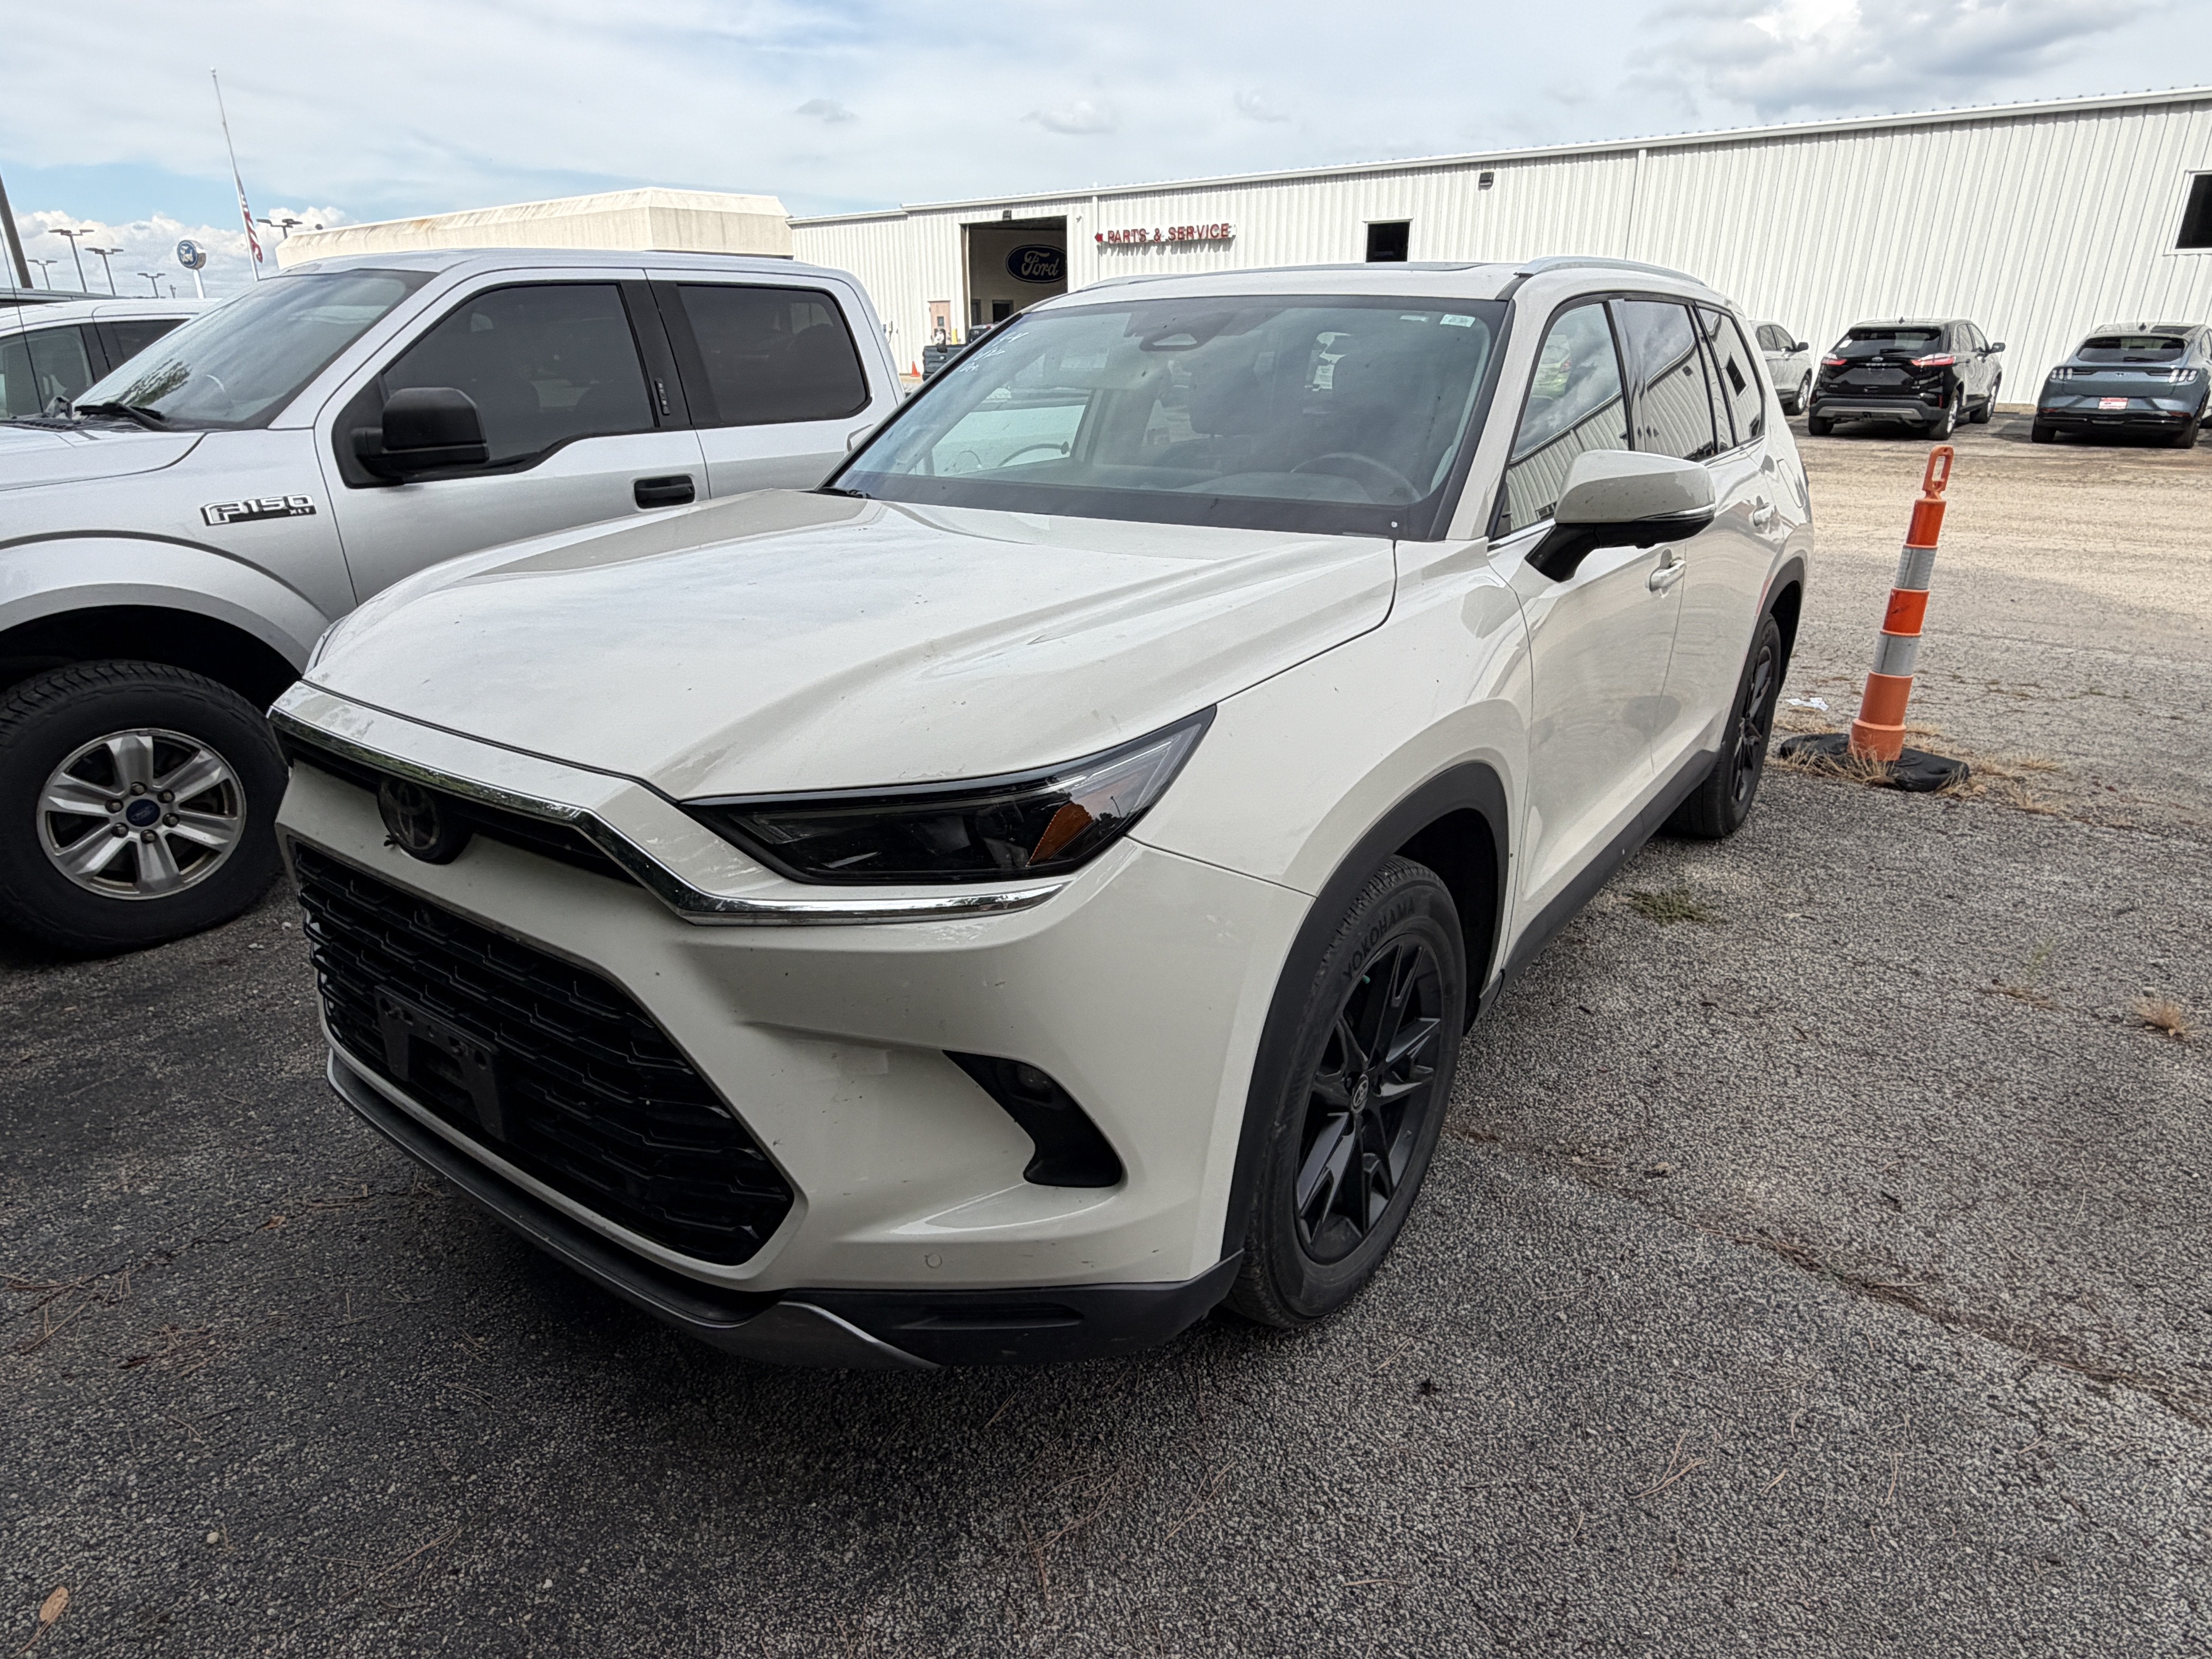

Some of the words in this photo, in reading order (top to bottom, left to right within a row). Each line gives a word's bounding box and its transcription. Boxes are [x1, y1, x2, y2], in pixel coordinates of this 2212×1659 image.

[1108, 228, 1147, 244] PARTS
[1153, 228, 1162, 242] &
[1168, 223, 1229, 241] SERVICE
[1021, 251, 1060, 276] Ford
[1342, 896, 1415, 980] YOKOHAMA
